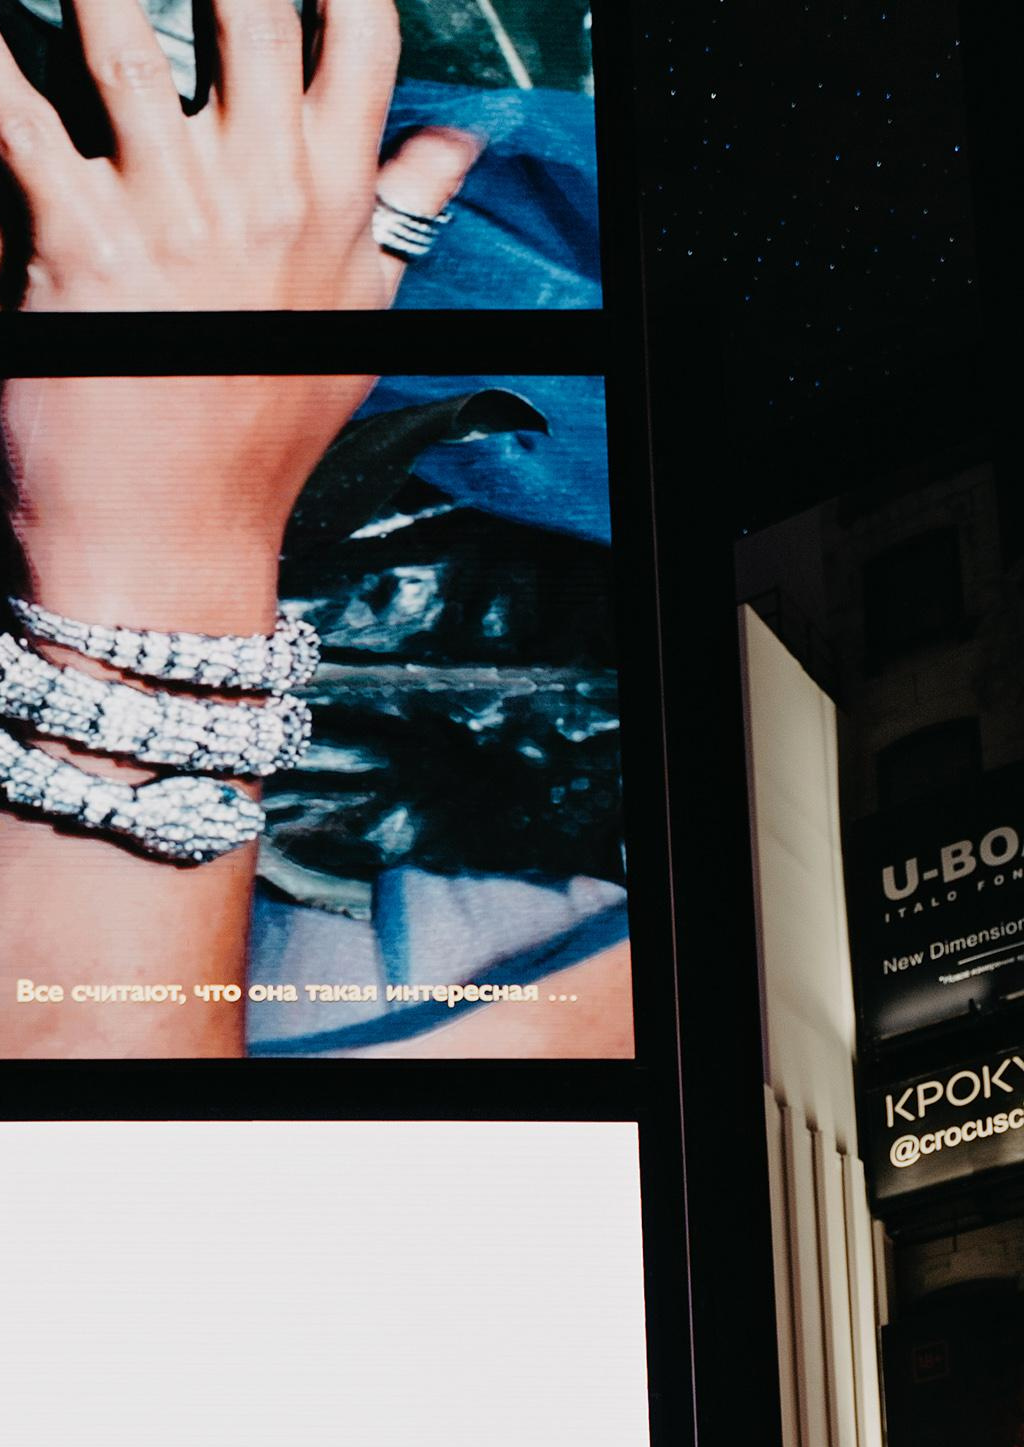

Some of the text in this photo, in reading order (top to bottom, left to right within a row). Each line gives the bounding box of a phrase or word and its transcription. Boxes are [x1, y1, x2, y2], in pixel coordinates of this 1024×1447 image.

[882, 826, 1024, 901] U-BO
[884, 890, 957, 923] ITALO
[882, 951, 924, 975] New
[16, 979, 64, 1002] Все
[71, 984, 186, 1005] считают,
[194, 984, 242, 1002] что
[248, 984, 298, 1002] она
[304, 984, 378, 1002] такая
[385, 984, 539, 1008] интересная
